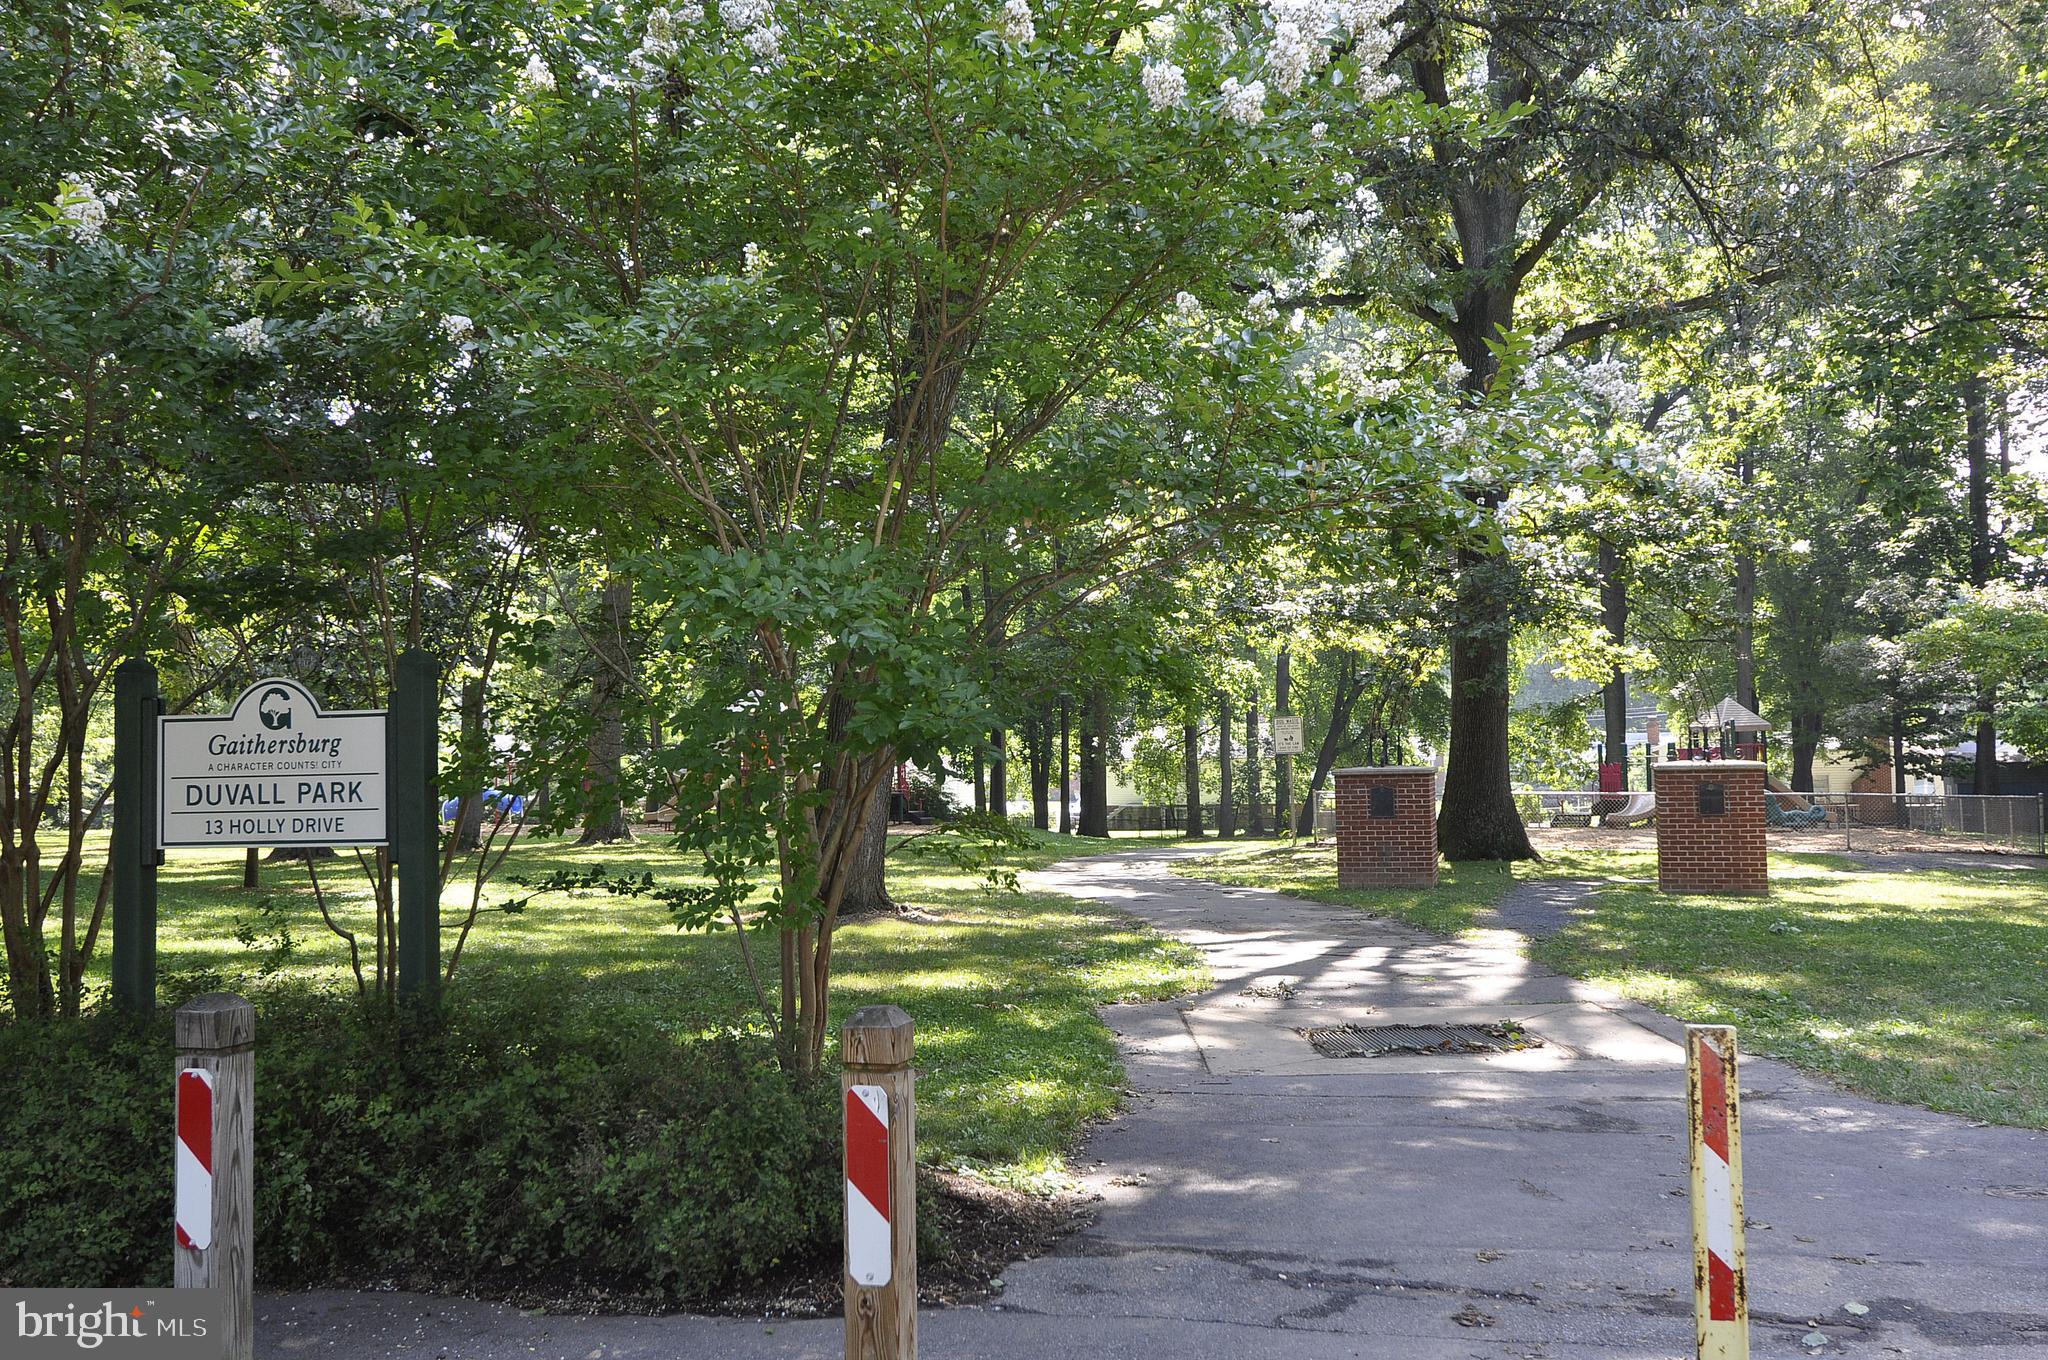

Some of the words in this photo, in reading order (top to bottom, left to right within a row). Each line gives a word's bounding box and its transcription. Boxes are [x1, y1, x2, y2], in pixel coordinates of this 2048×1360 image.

[208, 732, 342, 757] Gaithersburg
[208, 763, 214, 772] A
[217, 762, 274, 771] CHARACTER
[321, 760, 343, 769] CITY
[186, 782, 286, 806] DUVALL
[297, 780, 364, 804] PARK
[205, 819, 223, 835] 13
[229, 818, 286, 834] HOLLY
[292, 817, 345, 833] DRIVE
